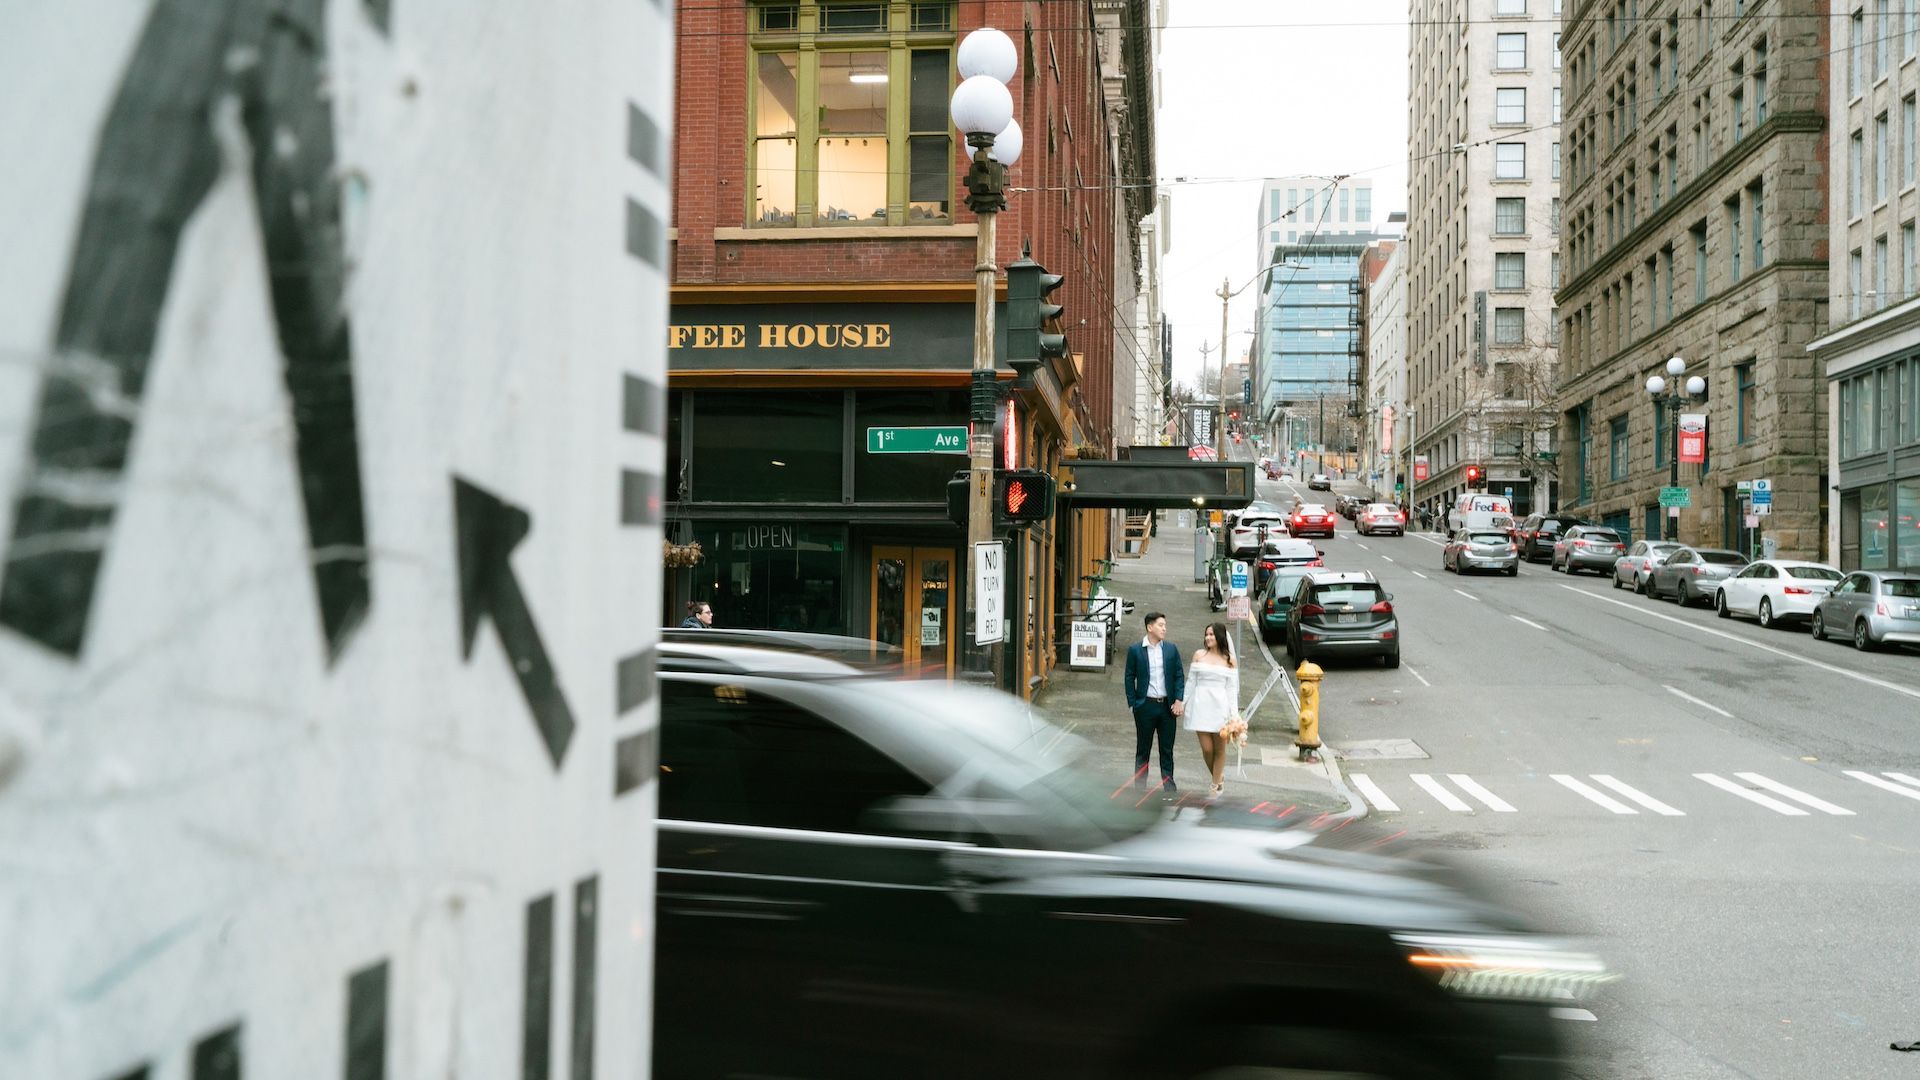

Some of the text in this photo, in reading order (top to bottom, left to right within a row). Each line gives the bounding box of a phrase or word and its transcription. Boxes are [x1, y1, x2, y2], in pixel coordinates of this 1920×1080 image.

[668, 324, 891, 349] FEE HOUSE
[1202, 409, 1211, 445] SQUARE
[877, 430, 960, 449] 1st Ave
[1474, 502, 1507, 513] FedEx
[747, 525, 792, 548] OPEN
[985, 550, 998, 570] NO
[983, 576, 1000, 592] TURN
[987, 598, 996, 613] ON
[985, 619, 997, 635] RED
